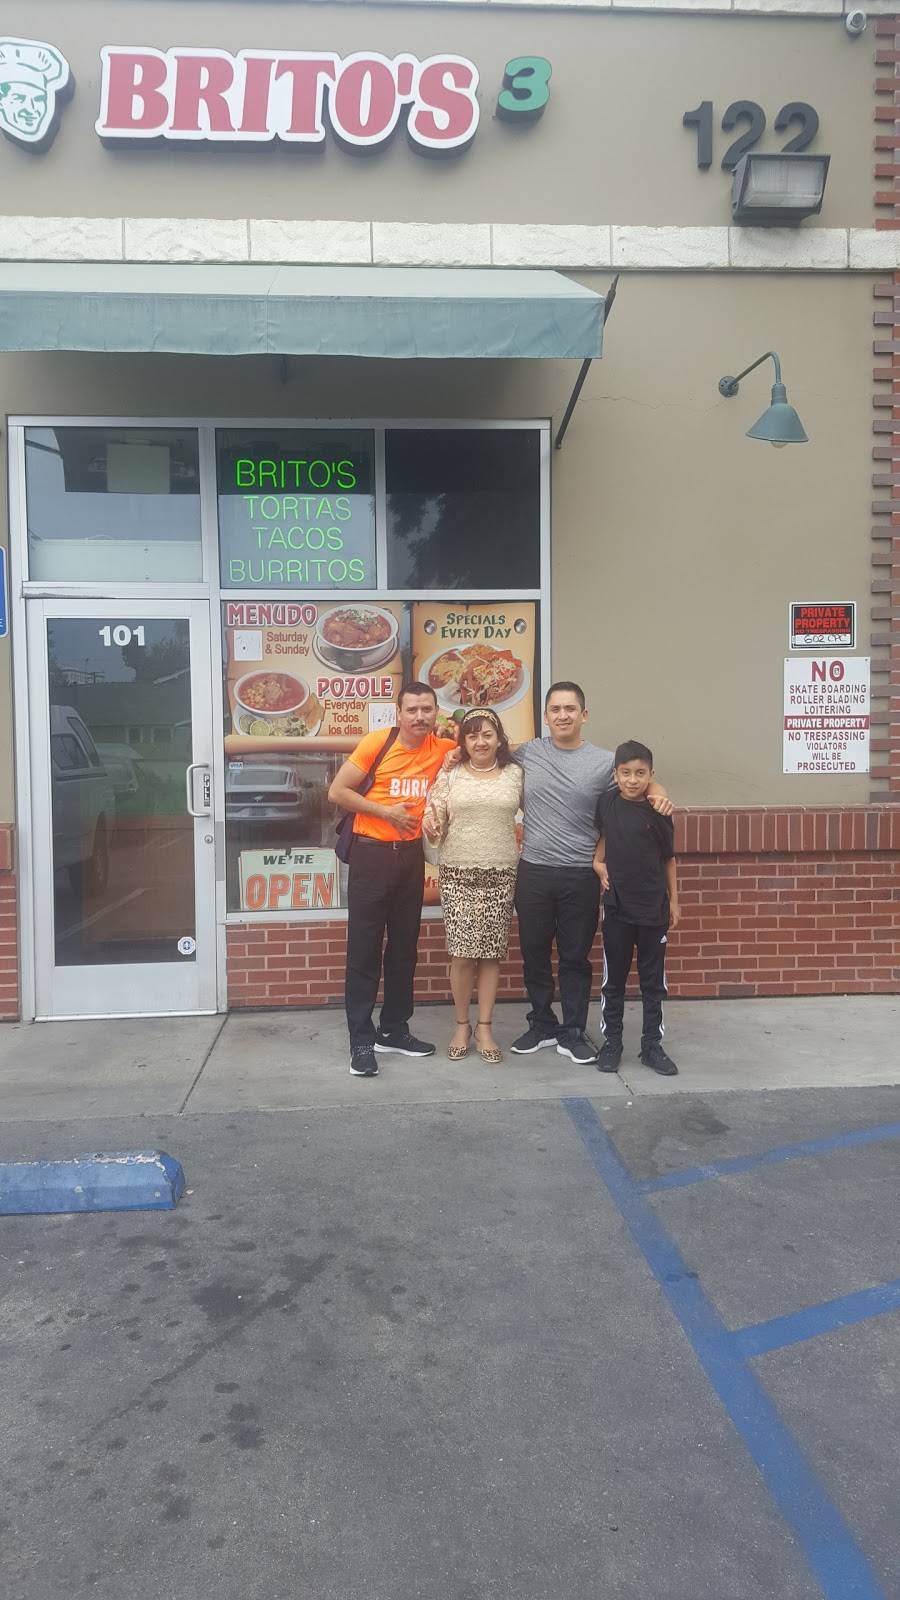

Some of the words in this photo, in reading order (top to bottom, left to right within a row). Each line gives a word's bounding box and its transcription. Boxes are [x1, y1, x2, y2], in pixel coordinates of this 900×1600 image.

[98, 50, 478, 143] BRITO'S
[499, 56, 553, 112] 3
[683, 100, 819, 169] 122
[236, 459, 357, 489] BRITO'S
[243, 495, 352, 521] TORTAS
[252, 526, 344, 551] TACOS
[229, 558, 365, 583] BURRITOS
[227, 603, 318, 626] MENUDO
[801, 607, 846, 617] PRIVATE
[446, 612, 506, 625] SPECIALS
[795, 618, 850, 629] PROPERTY
[99, 625, 145, 646] 101
[266, 631, 308, 643] Saturday
[441, 626, 480, 639] EVERY
[484, 626, 512, 638] DAY
[265, 644, 273, 654] &
[275, 644, 310, 656] Sunday
[811, 660, 845, 682] NO
[317, 676, 394, 700] POZOLE
[789, 684, 818, 694] SKATE
[821, 684, 867, 693] BOARDING
[324, 699, 367, 712] Everyday
[790, 695, 824, 704] ROLLER
[827, 695, 865, 704] BLADING
[804, 705, 851, 714] LOITERING
[332, 712, 359, 723] Todos
[787, 718, 822, 728] PRIVATE
[823, 718, 866, 727] PROPERTY
[328, 725, 341, 735] los
[788, 732, 801, 741] NO
[804, 731, 865, 740] TRESPASSING
[806, 742, 847, 750] VIOLATORS
[812, 752, 830, 760] WILL
[831, 752, 842, 760] BE
[797, 762, 856, 771] PROSECUTED
[263, 854, 315, 865] WE'RE
[245, 873, 335, 911] OPEN
